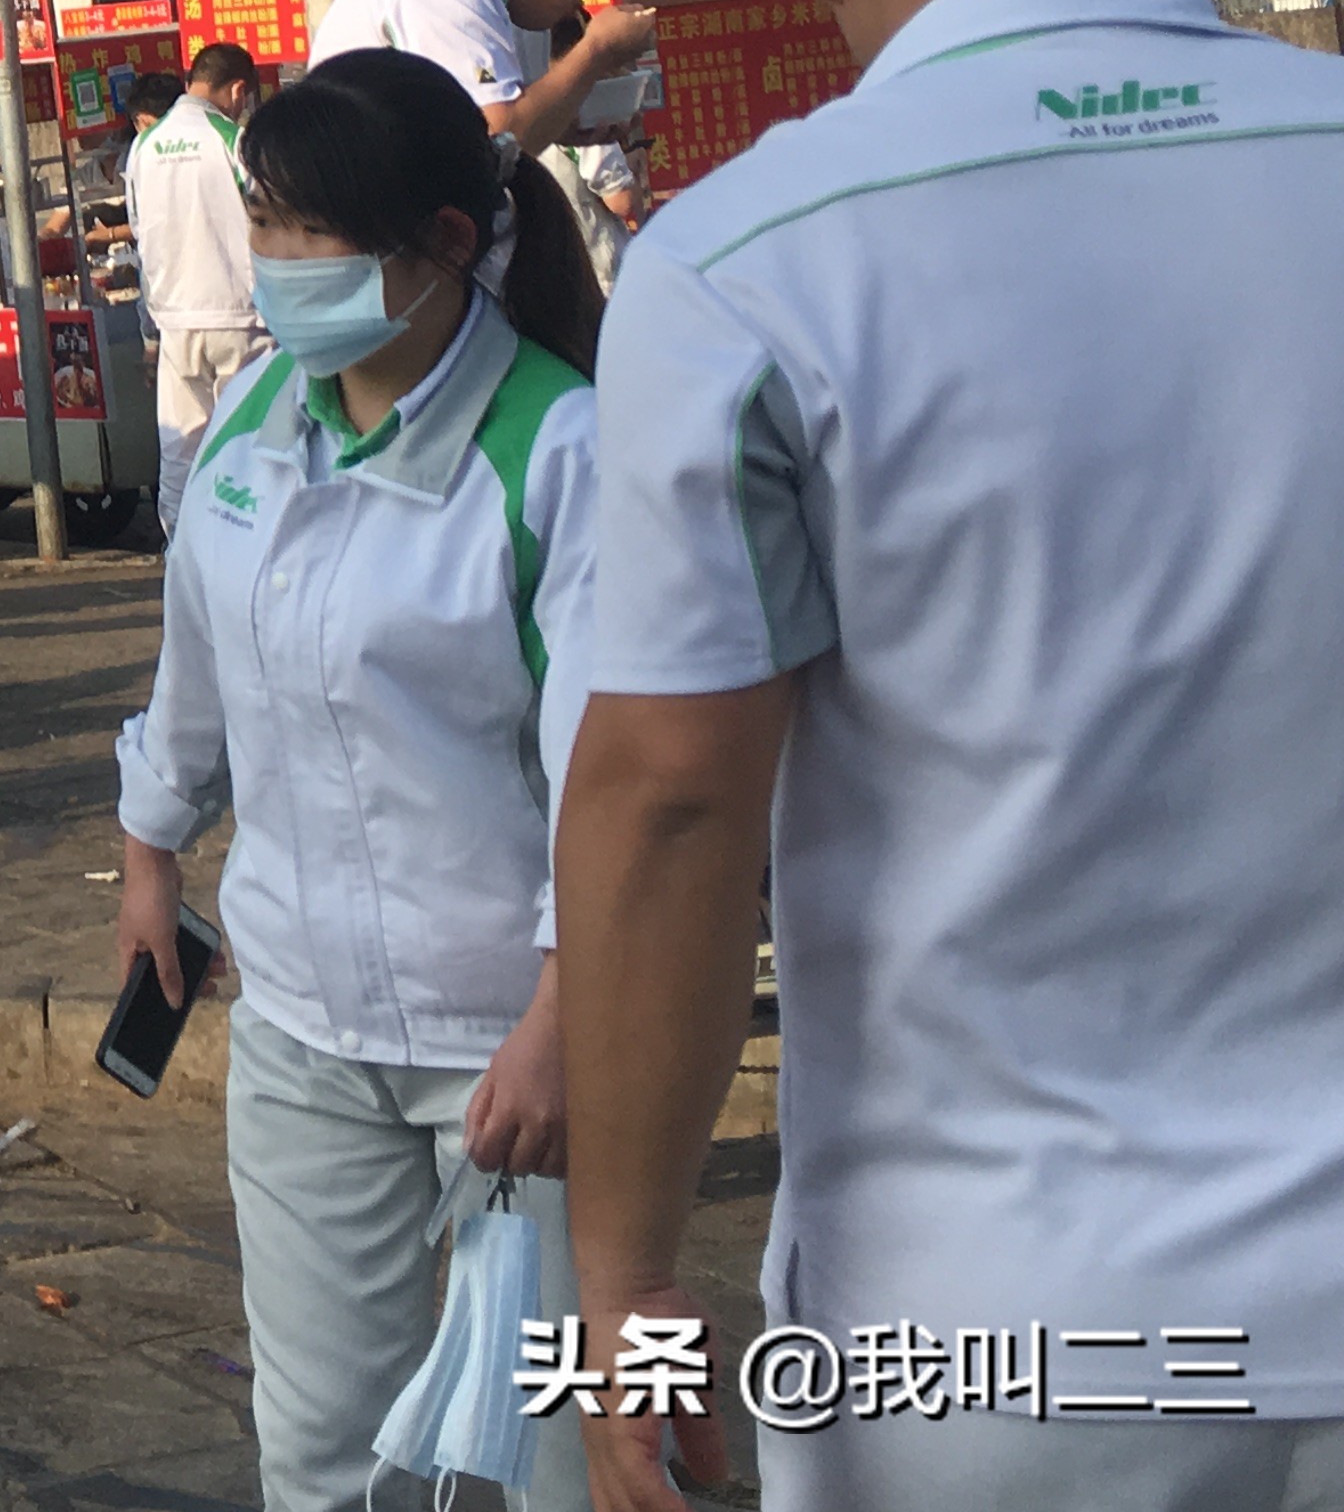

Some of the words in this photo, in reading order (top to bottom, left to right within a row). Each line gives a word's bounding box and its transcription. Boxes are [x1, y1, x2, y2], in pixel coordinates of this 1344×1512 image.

[1069, 124, 1098, 139] All
[1101, 122, 1134, 137] for
[1138, 111, 1220, 134] dreams
